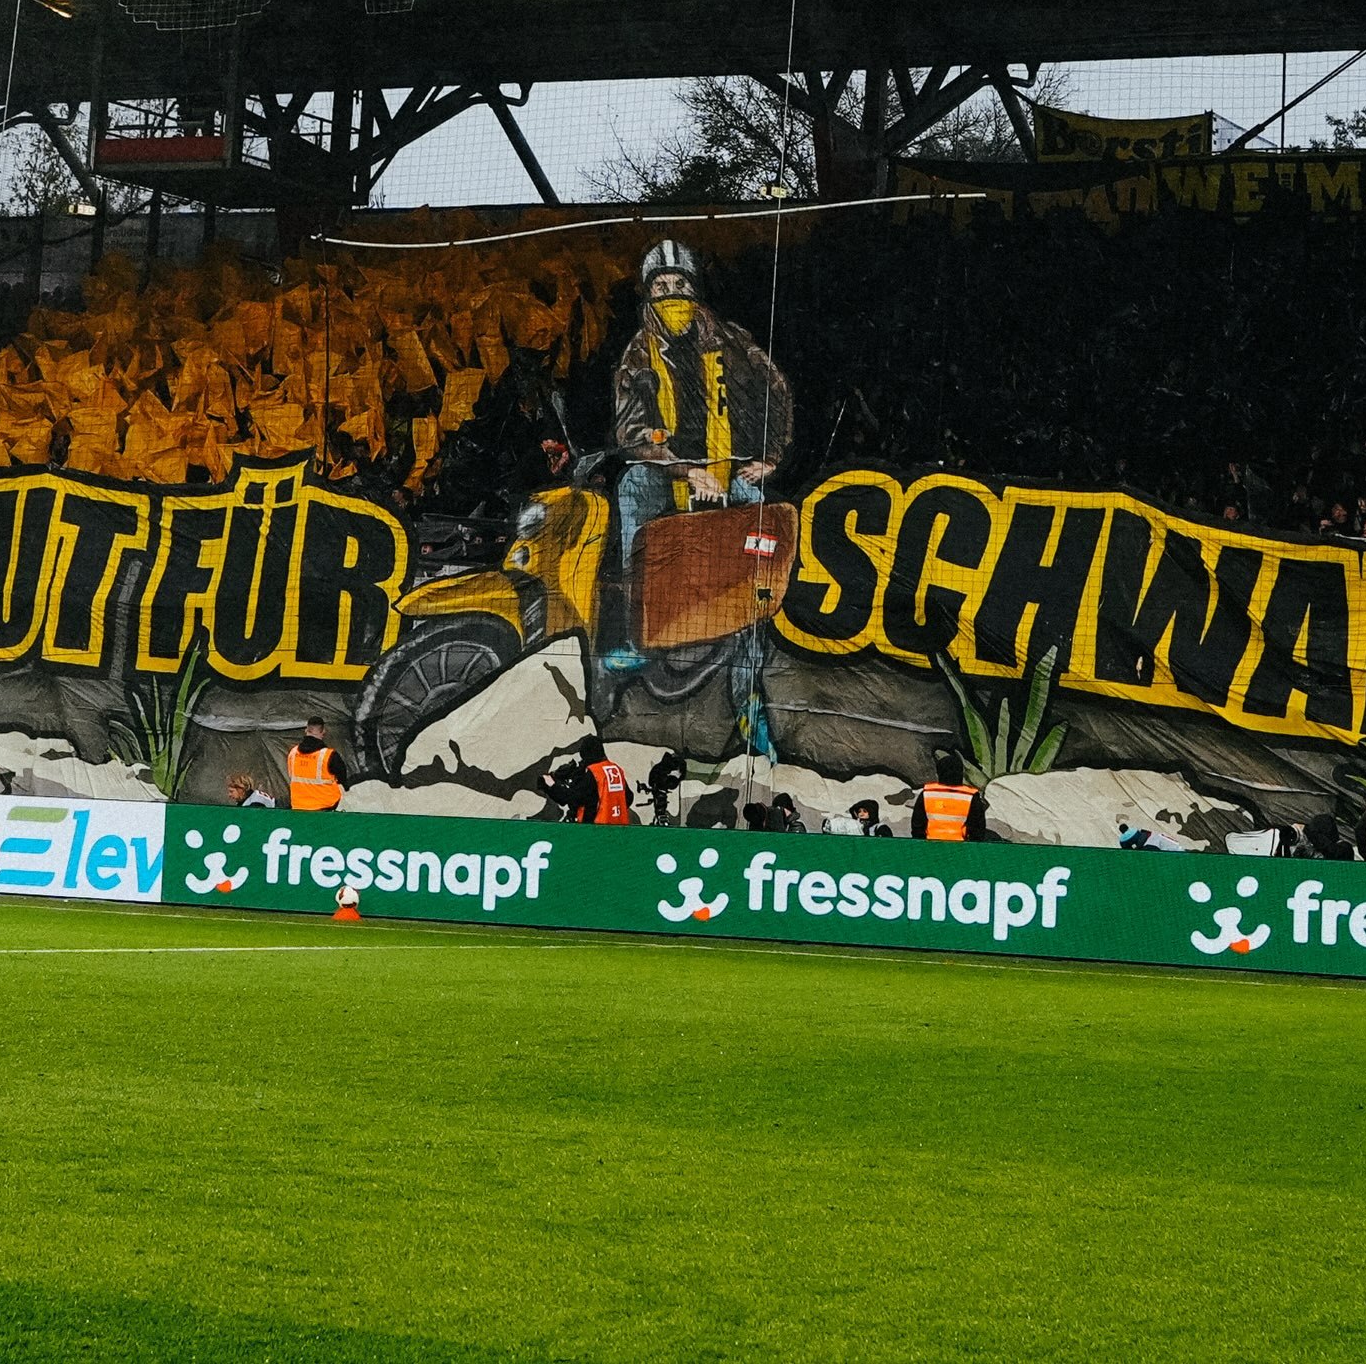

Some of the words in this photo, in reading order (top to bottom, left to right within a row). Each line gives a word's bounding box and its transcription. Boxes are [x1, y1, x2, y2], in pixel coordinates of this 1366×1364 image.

[137, 462, 410, 681] FÜR
[262, 827, 552, 911] fressnapf
[744, 851, 1071, 941] fressnapf
